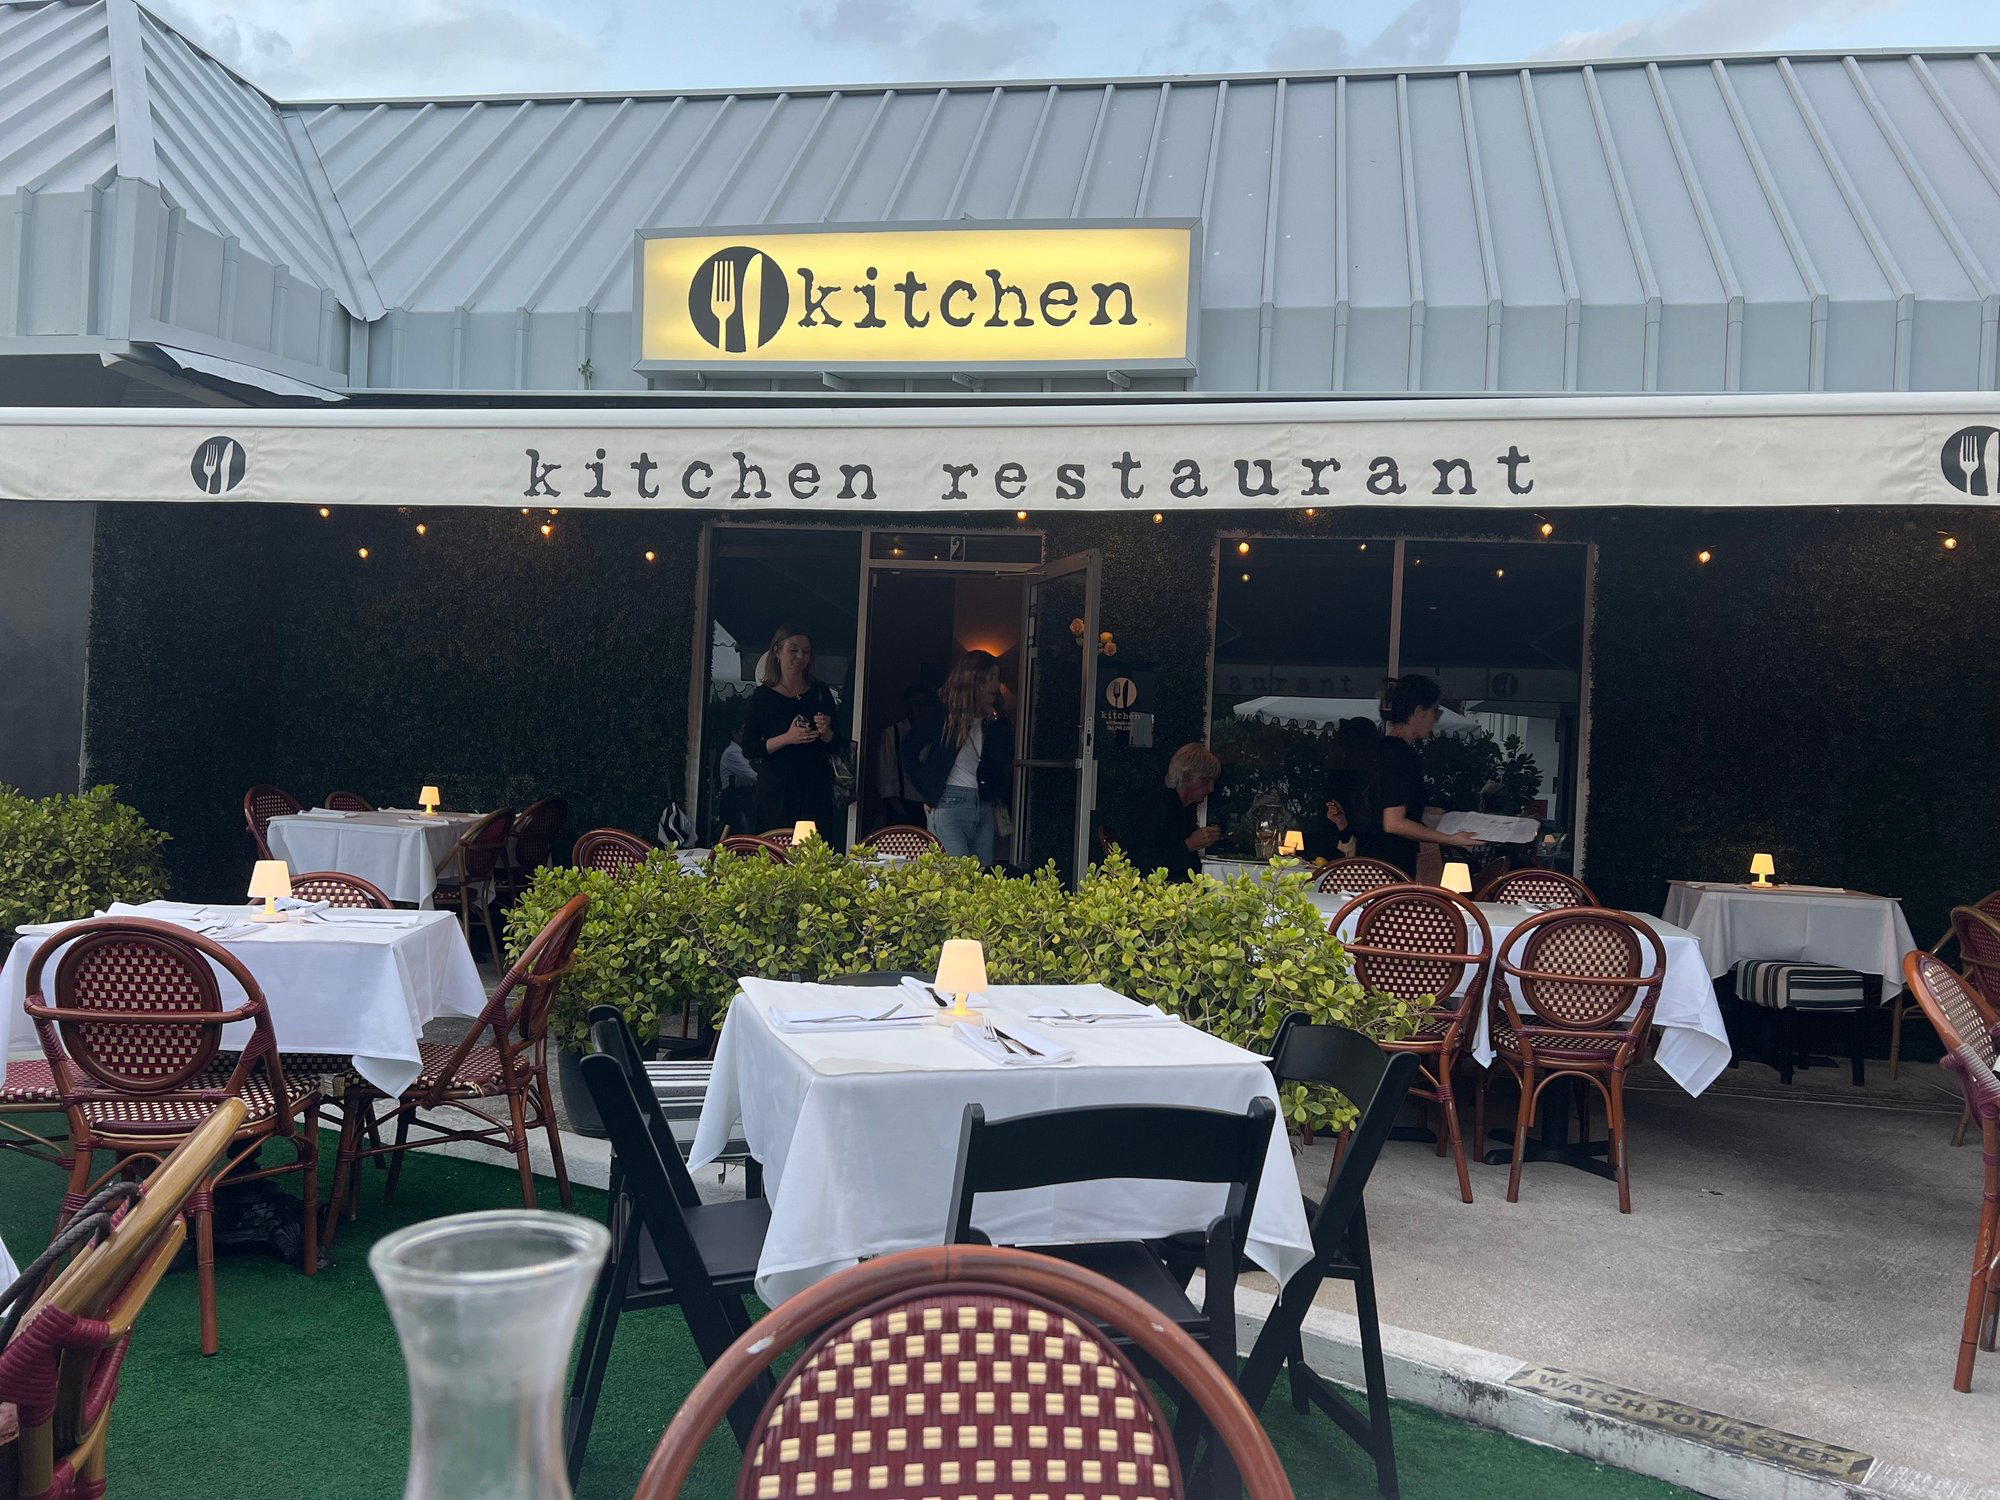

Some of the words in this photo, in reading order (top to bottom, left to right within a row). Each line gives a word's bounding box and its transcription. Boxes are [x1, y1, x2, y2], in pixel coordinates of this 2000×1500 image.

[796, 266, 1138, 329] kitchen
[524, 447, 877, 500] kitchen
[941, 445, 1536, 500] restaurant
[952, 537, 964, 560] 2
[1538, 1373, 1646, 1413] WATCH
[1656, 1405, 1745, 1441] YOUR
[1751, 1435, 1844, 1465] STEP
